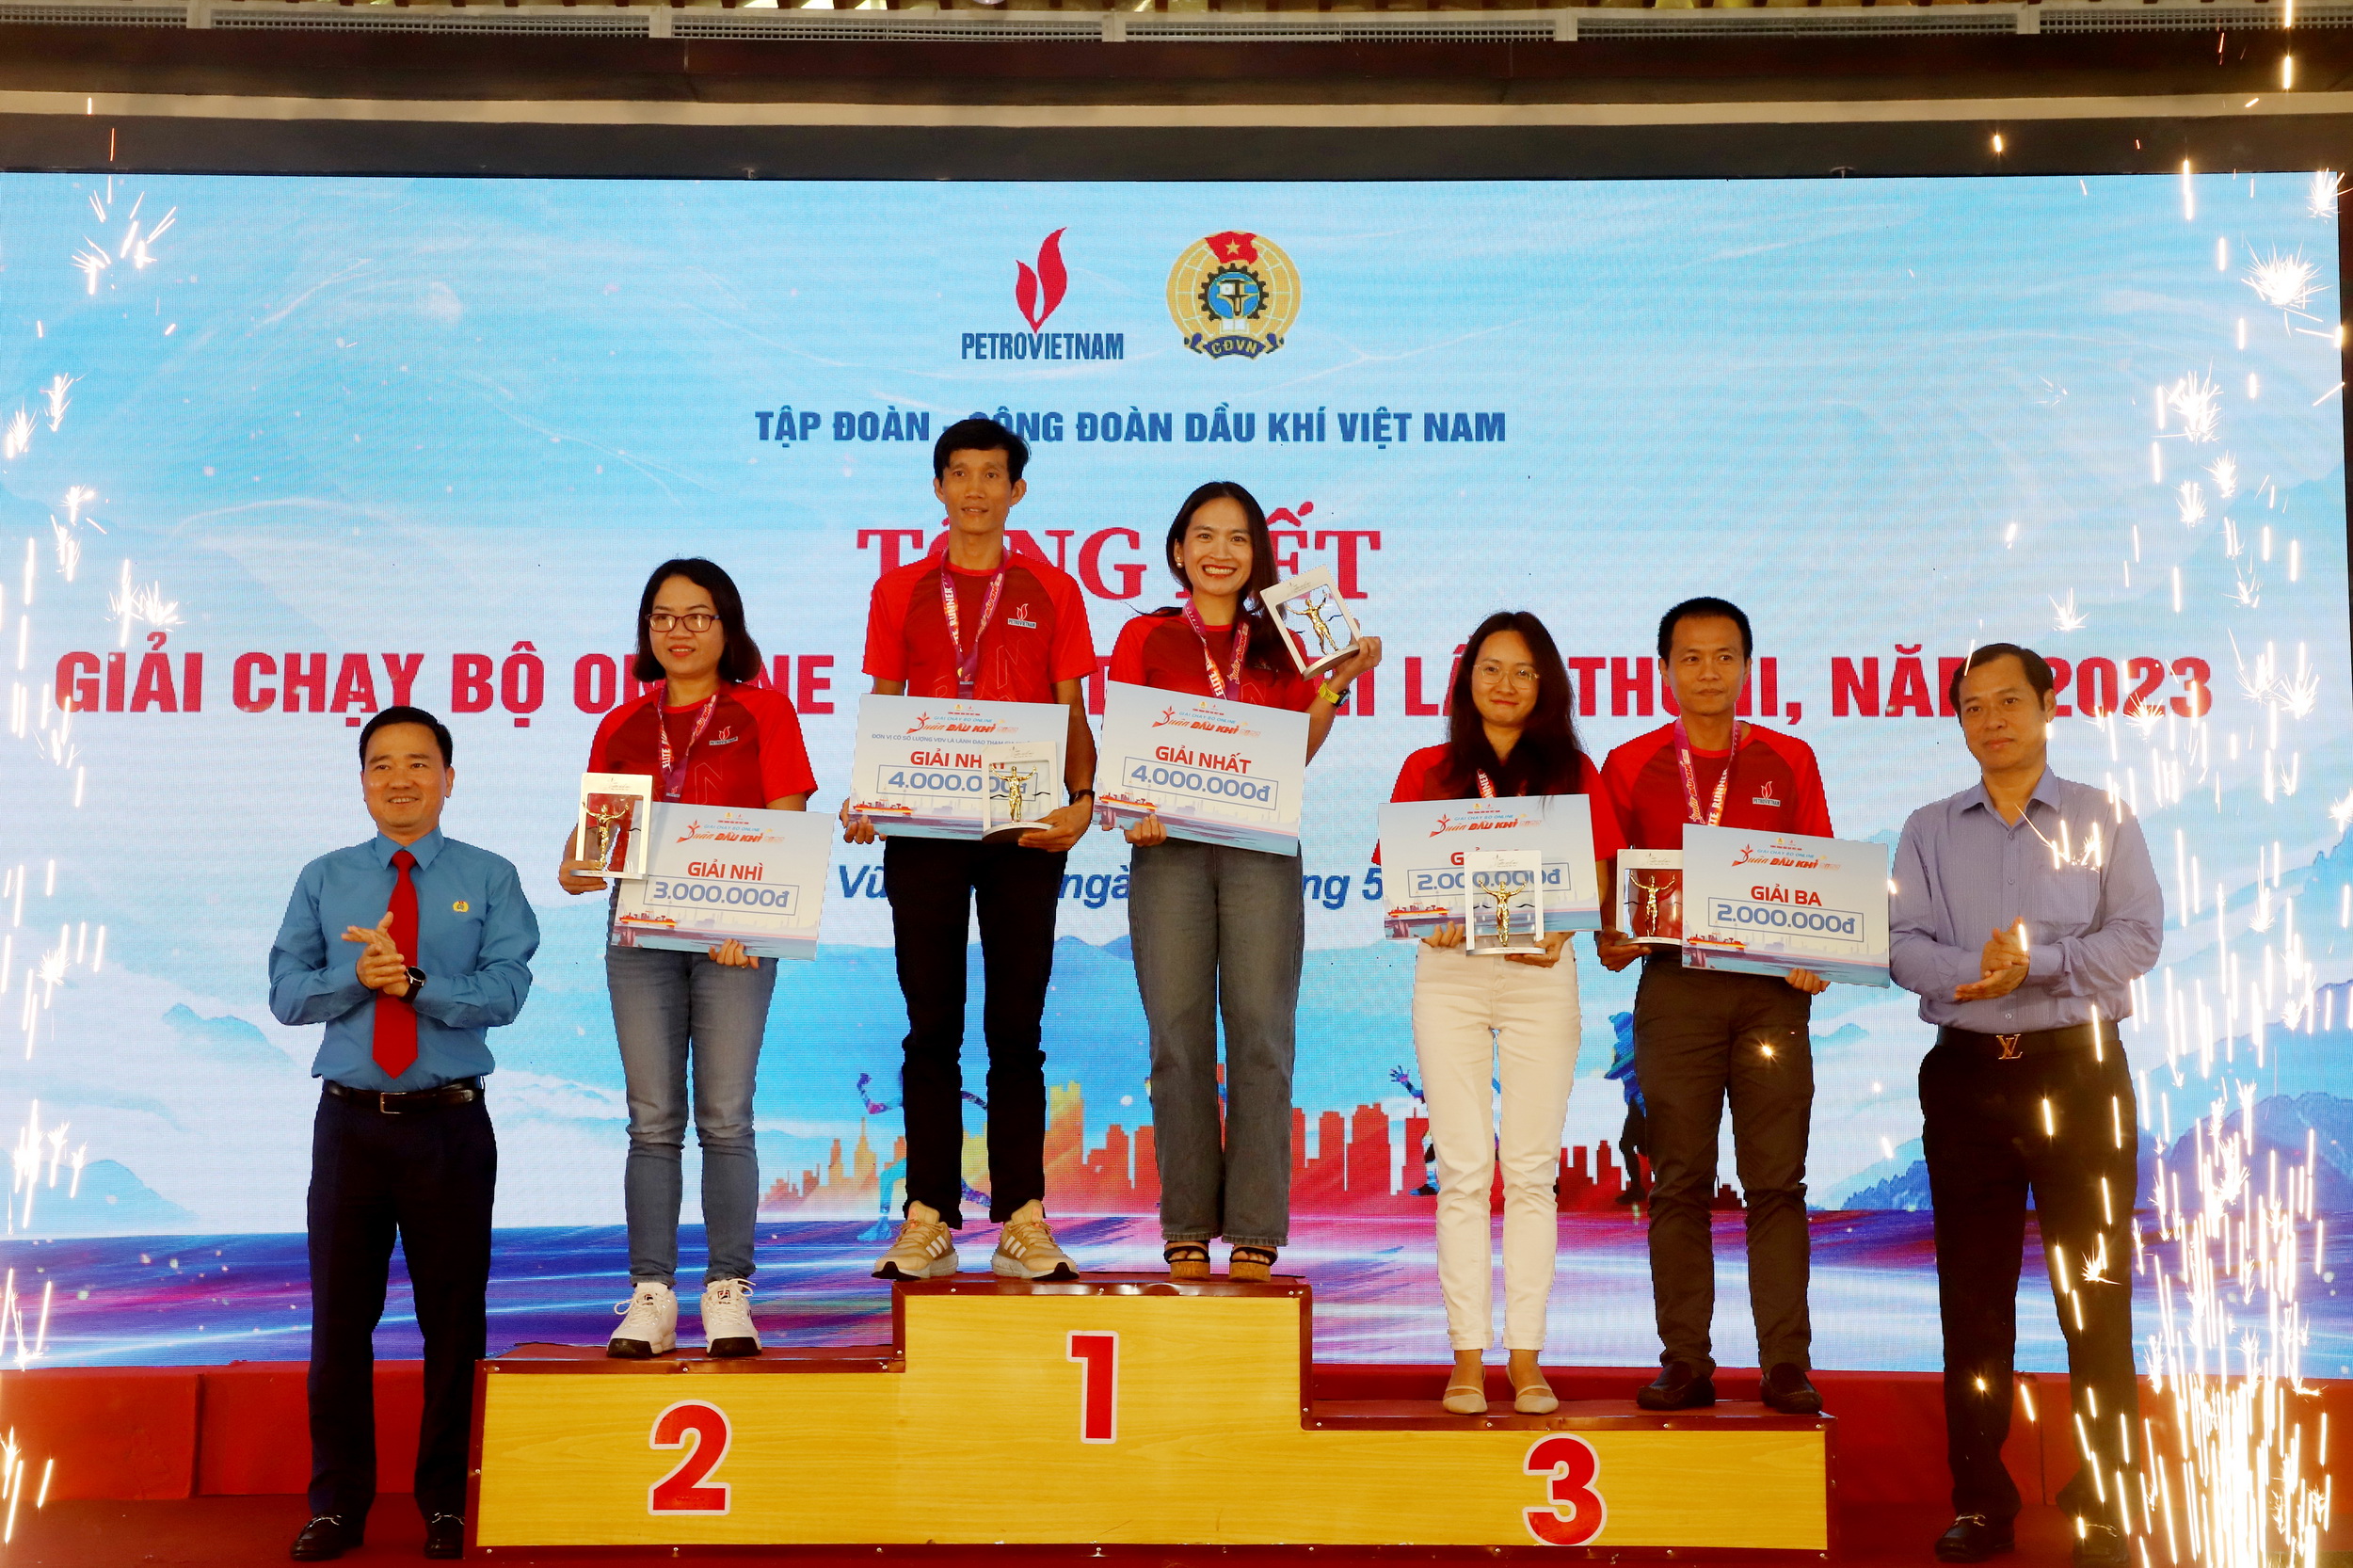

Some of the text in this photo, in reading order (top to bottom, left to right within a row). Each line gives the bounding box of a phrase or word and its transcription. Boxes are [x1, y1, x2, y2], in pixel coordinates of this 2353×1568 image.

[960, 332, 1124, 360] PETROVIETNAM
[755, 405, 822, 448] TẬP
[833, 406, 930, 441] ĐOÀN
[1076, 406, 1173, 442] ĐOÀN
[1185, 401, 1256, 442] DẦU
[1268, 406, 1326, 442] KHÍ
[1337, 406, 1413, 450] VIỆT
[1423, 412, 1506, 442] NAM
[55, 632, 203, 713] GIẢI
[232, 651, 424, 728] CHẠY
[452, 641, 544, 728] BỘ
[910, 748, 950, 766] GIẢI
[1156, 745, 1251, 775] GIẢI NHẤT
[1131, 765, 1271, 802] 4.000.000đ
[688, 858, 763, 881] GIẢI NHÌ
[653, 882, 790, 907] 3.000.000đ
[1751, 884, 1822, 906] GIẢI BA
[1717, 904, 1855, 934] 2.000.000đ
[1067, 1332, 1117, 1442] 1
[651, 1402, 728, 1512] 2
[1526, 1434, 1604, 1546] 3
